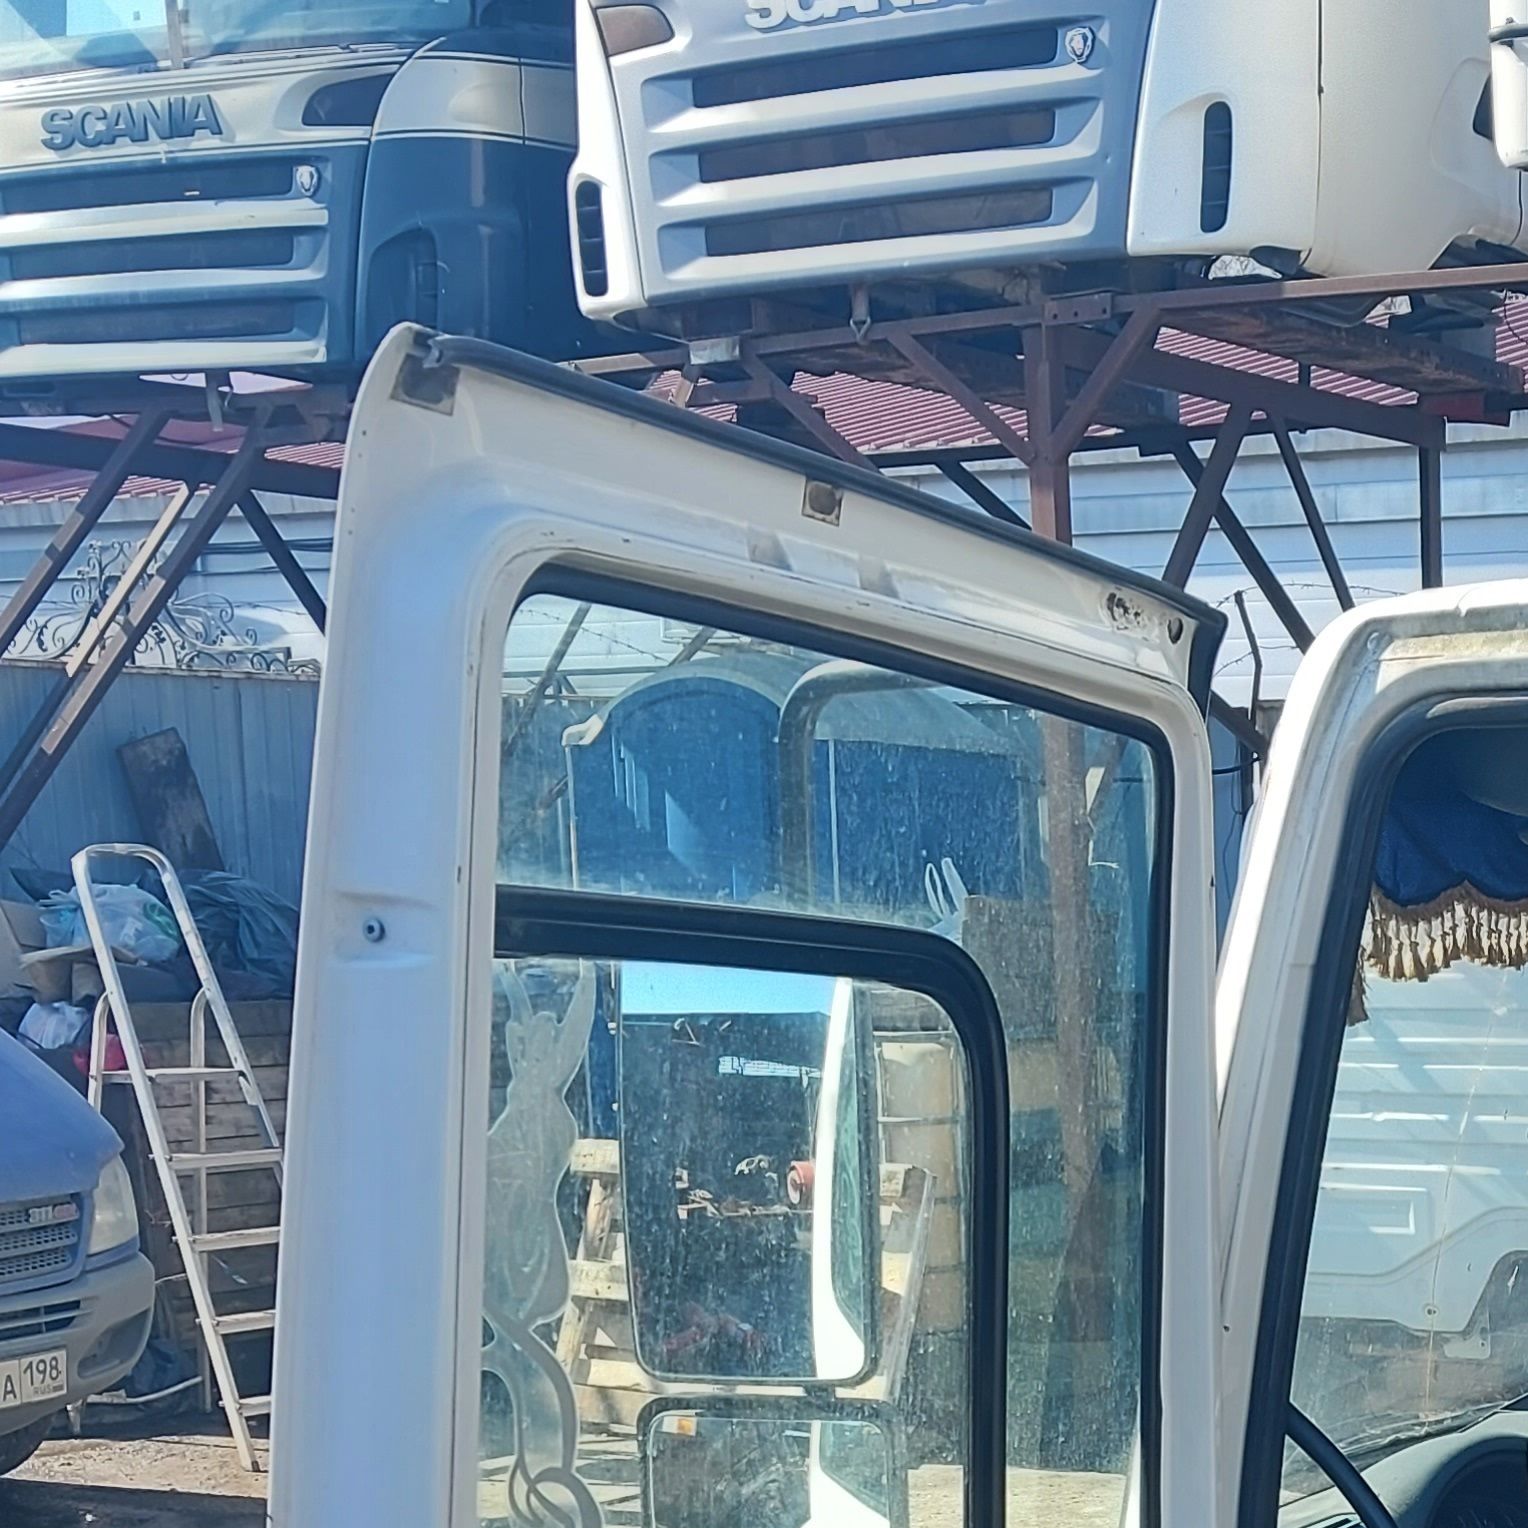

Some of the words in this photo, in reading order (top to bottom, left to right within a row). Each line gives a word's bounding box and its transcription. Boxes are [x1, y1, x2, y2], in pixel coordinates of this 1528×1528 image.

[41, 94, 222, 150] SCANIA
[3, 1374, 17, 1402] A
[23, 1356, 59, 1387] 198
